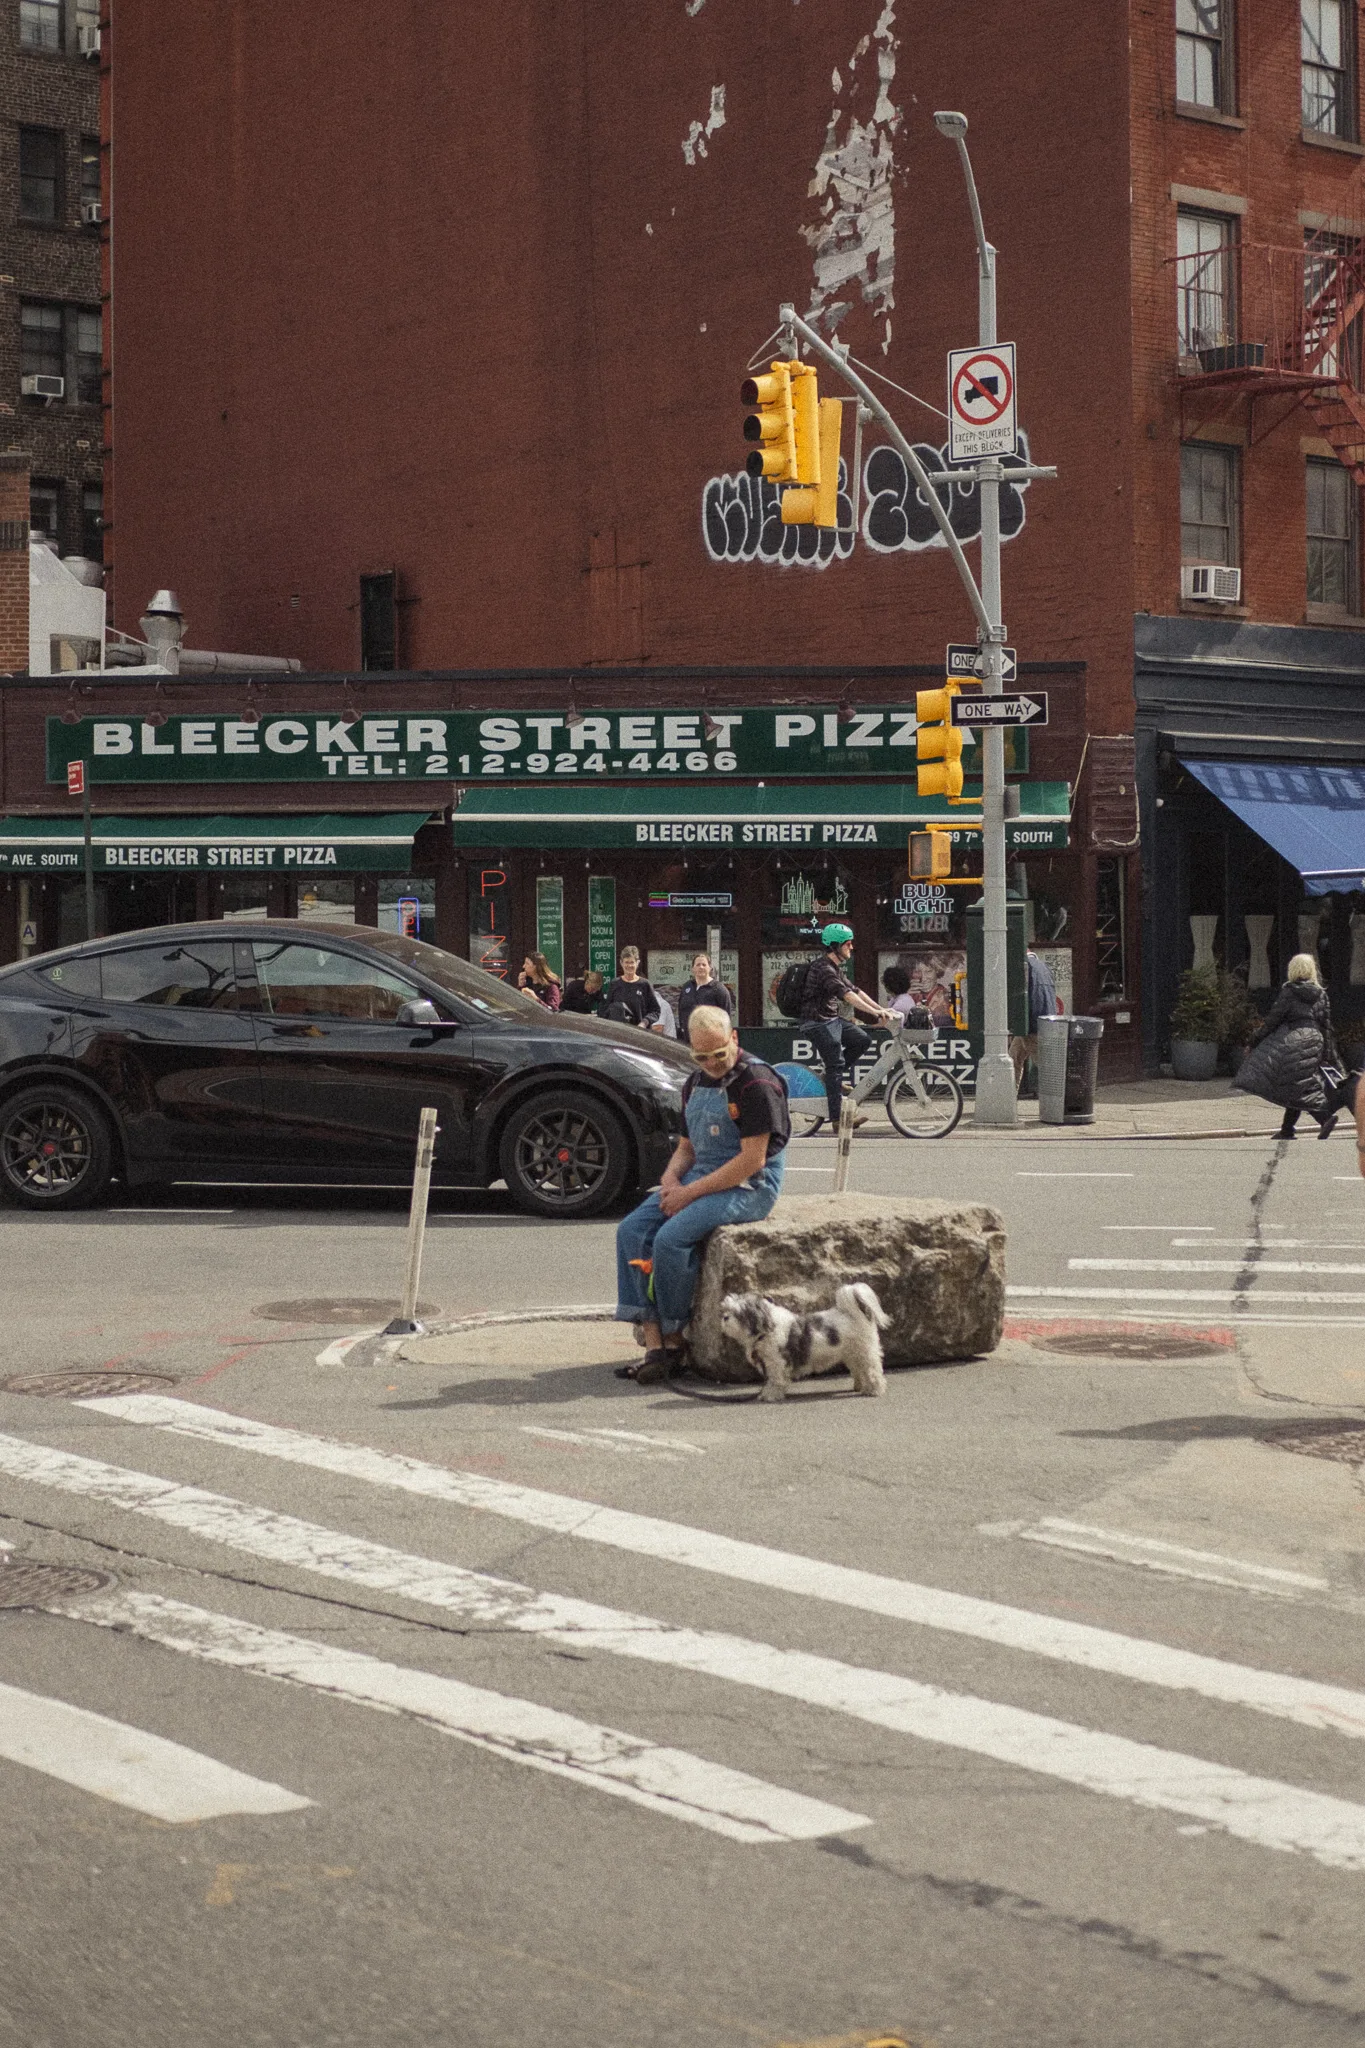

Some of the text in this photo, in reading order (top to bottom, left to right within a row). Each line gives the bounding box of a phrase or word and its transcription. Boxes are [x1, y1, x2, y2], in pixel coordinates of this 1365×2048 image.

[955, 432, 976, 443] EXCEPT
[963, 440, 1004, 454] THIS BLOCK
[954, 655, 975, 668] ONE
[965, 703, 1032, 717] ONE WAY
[93, 713, 976, 755] BLEECKER STREET PIZZ
[322, 751, 737, 775] TEL: 212-924-4466
[636, 823, 878, 843] BLEECKER STREET PIZZA
[1013, 831, 1053, 843] SOUTH
[12, 854, 36, 866] AVE.
[41, 854, 78, 866] SOUTH
[106, 846, 337, 866] BLEECKER STREET PIZZA
[902, 883, 945, 899] BUD
[895, 899, 954, 914] LIGHT
[592, 914, 612, 923] DINING
[900, 915, 949, 932] SELTZER
[22, 924, 34, 938] A
[591, 927, 608, 935] ROOM
[591, 939, 614, 948] COUNTER
[594, 951, 611, 960] OPEN
[595, 963, 610, 972] NEXT
